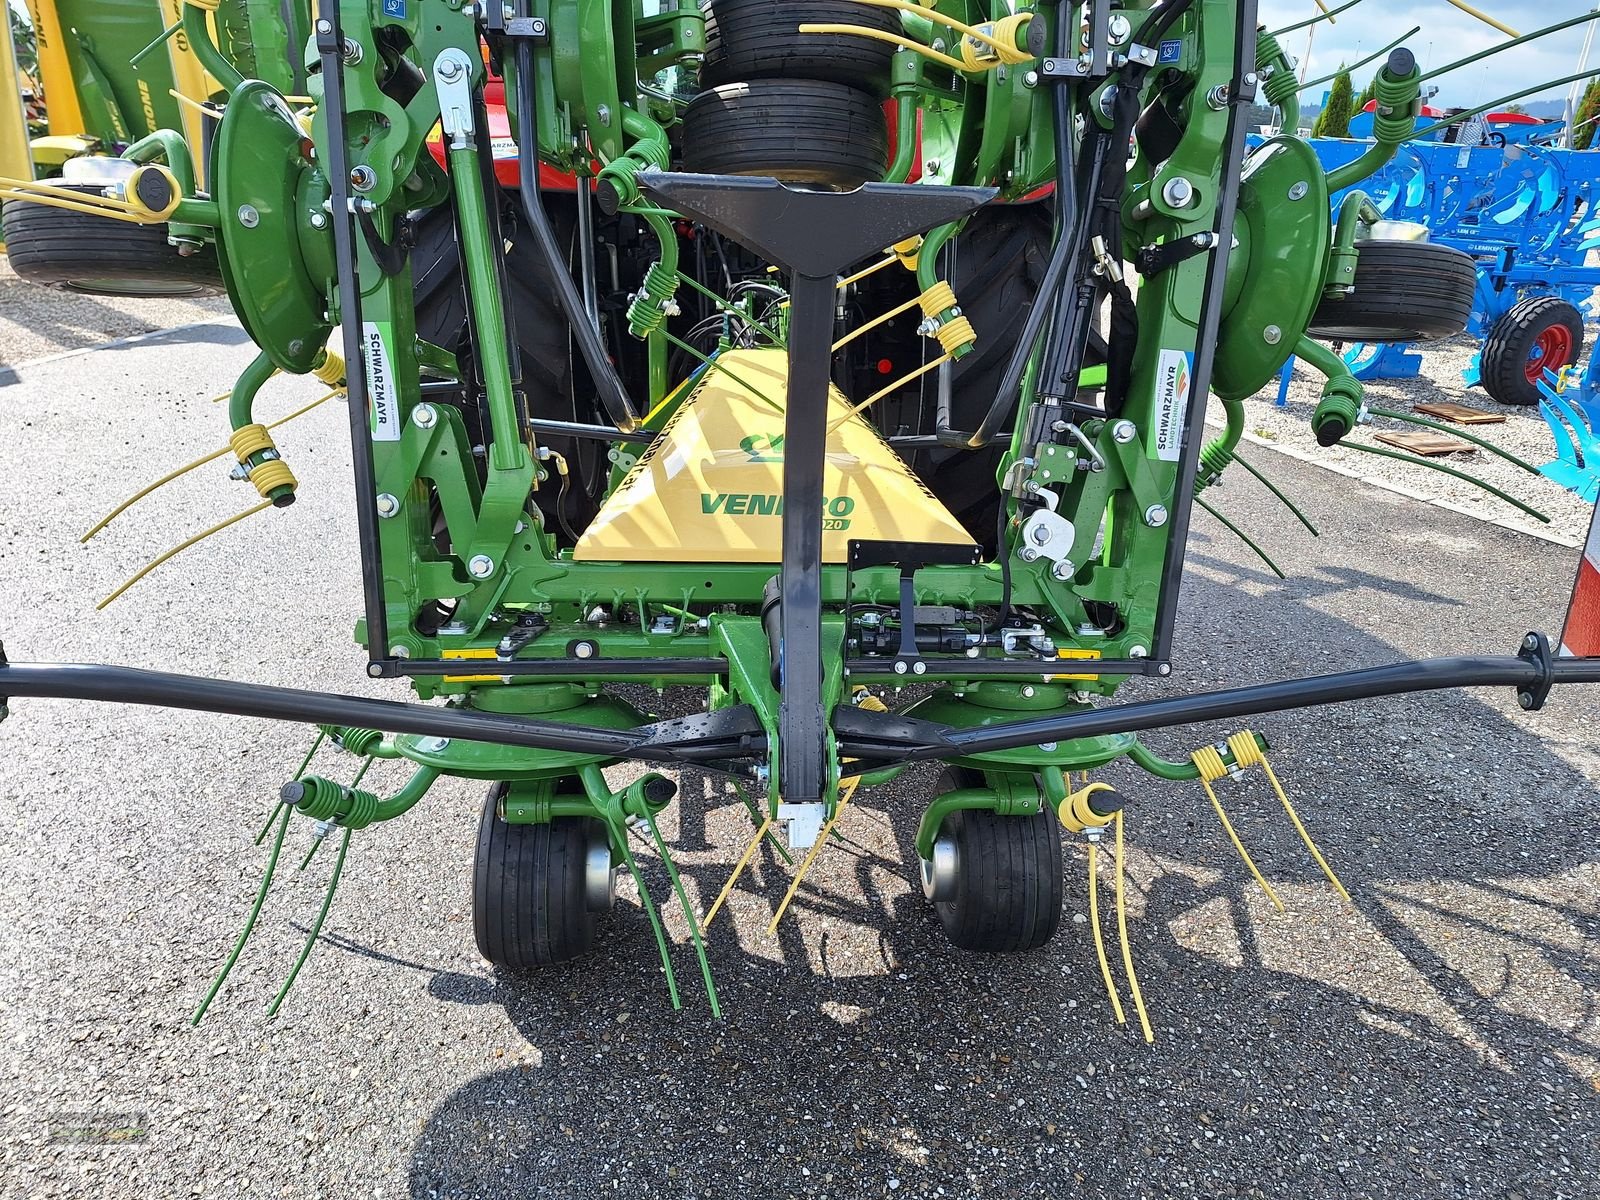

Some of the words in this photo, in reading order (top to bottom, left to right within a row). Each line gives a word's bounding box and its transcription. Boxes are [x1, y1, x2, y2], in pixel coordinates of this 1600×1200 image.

[370, 333, 387, 424] SCHWARZMAYR
[1158, 366, 1176, 450] SCHWARZMAYR
[1168, 401, 1180, 449] LANDTECHNIK
[700, 494, 855, 516] VENO
